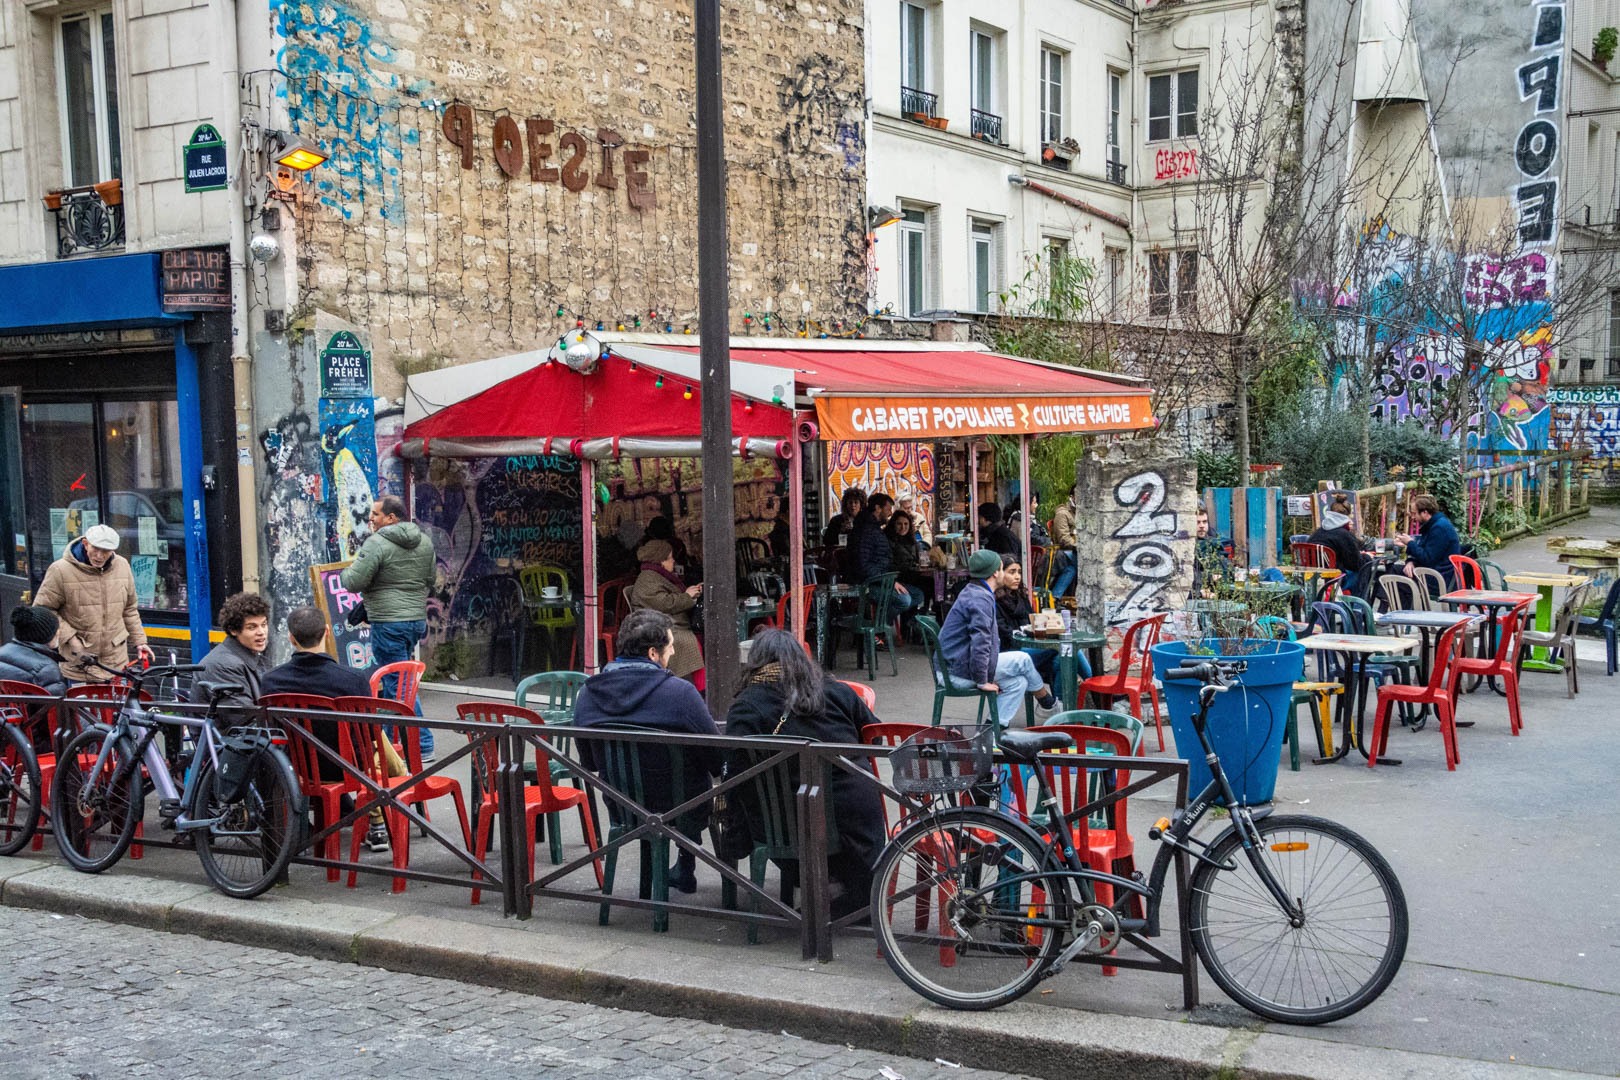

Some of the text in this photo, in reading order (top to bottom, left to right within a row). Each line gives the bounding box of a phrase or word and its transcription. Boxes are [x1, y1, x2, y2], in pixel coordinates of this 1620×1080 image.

[201, 155, 212, 163] RUE
[188, 166, 226, 178] JULIEN LACROIX
[169, 271, 225, 289] RAPIDE
[331, 357, 361, 367] PLACE
[328, 367, 365, 378] FRÉHEL
[852, 406, 1016, 432] CABARET POPULAIRE
[1033, 403, 1130, 426] CULTURE RAPIDE
